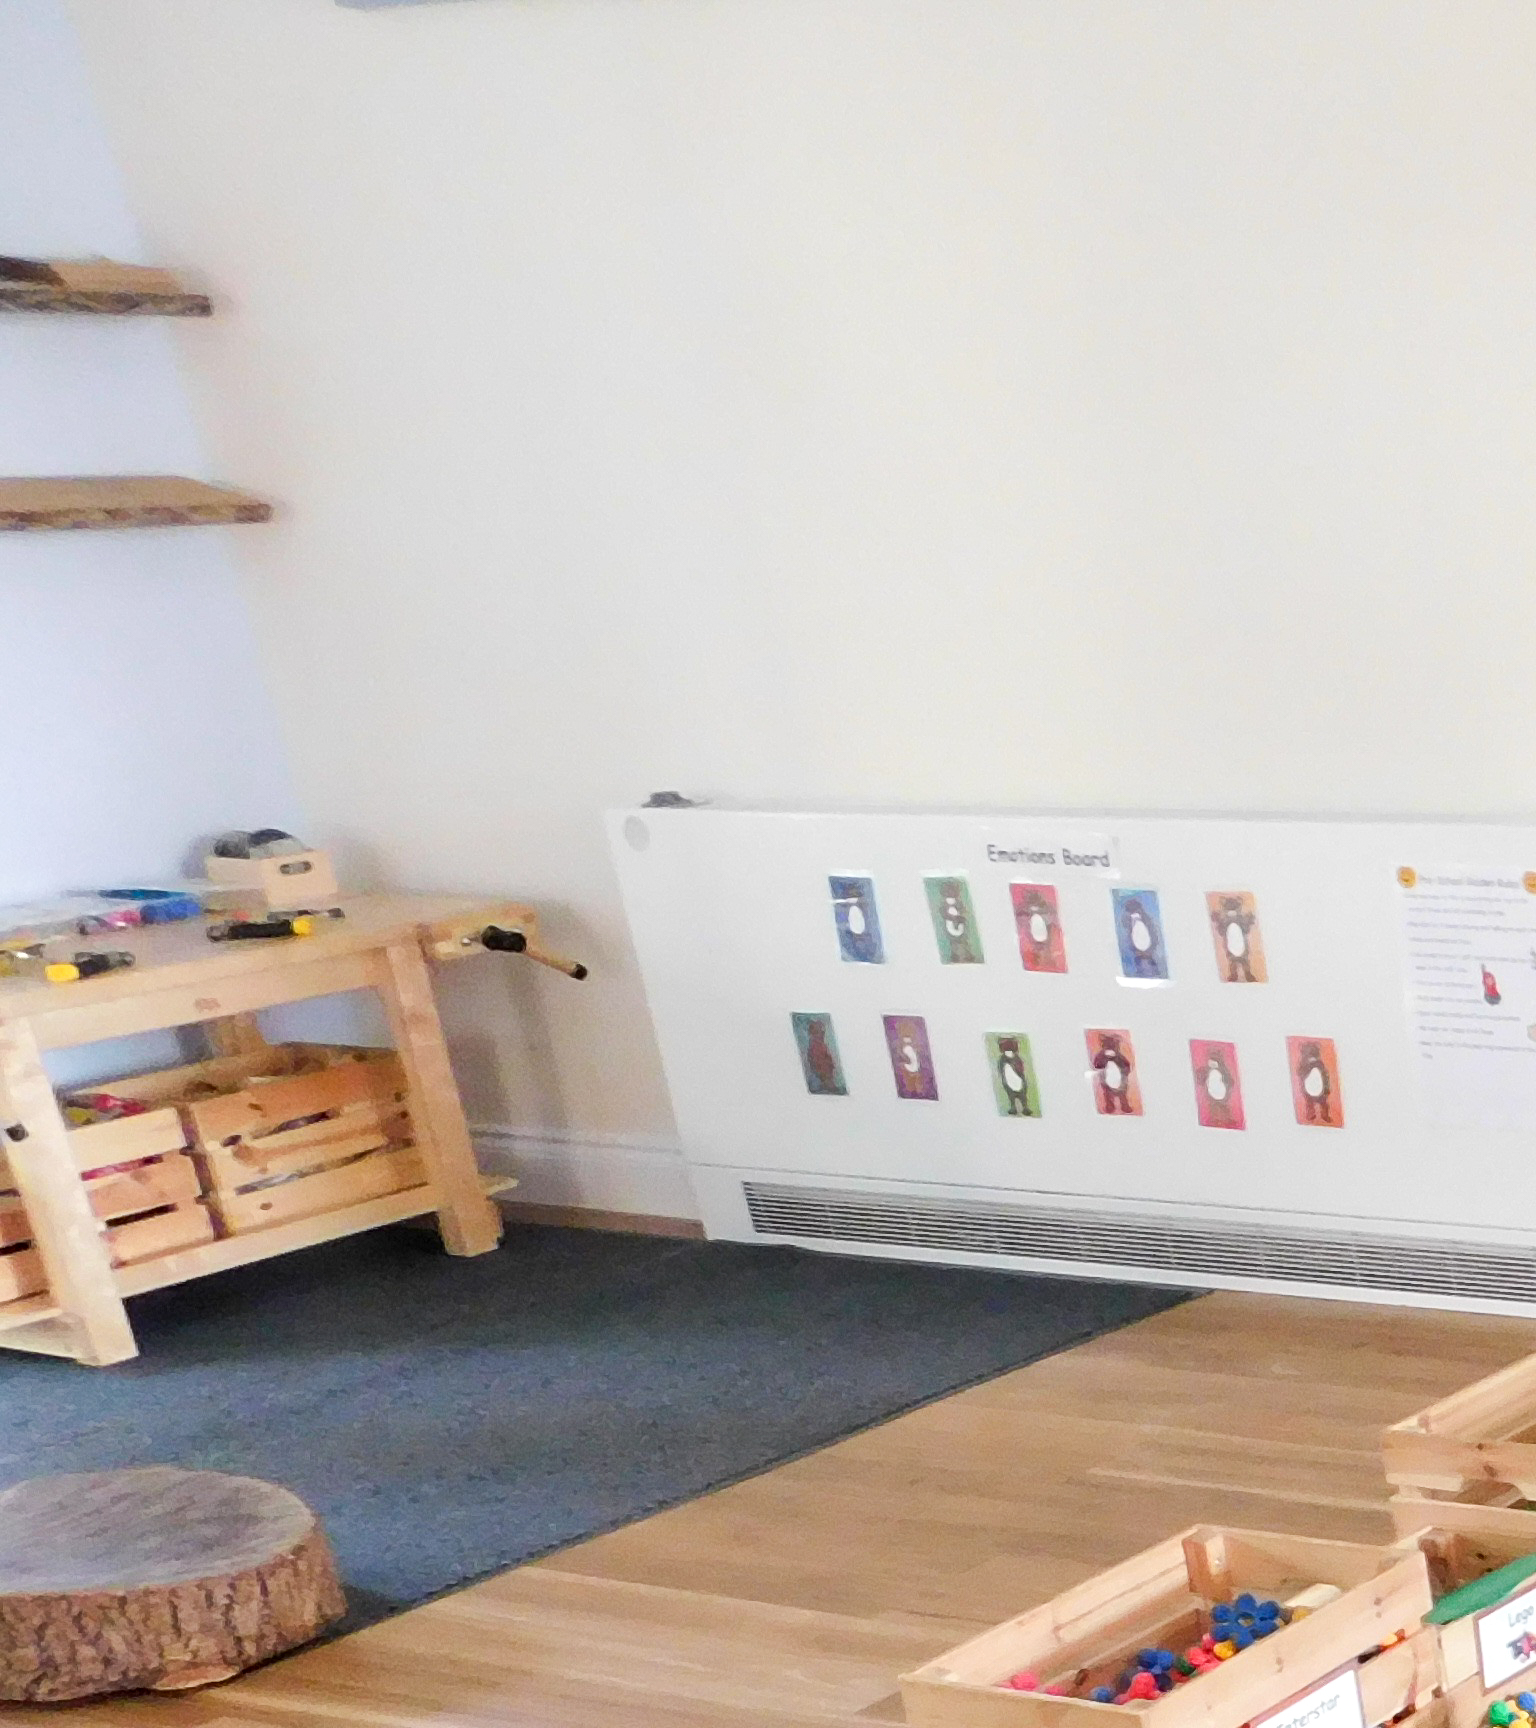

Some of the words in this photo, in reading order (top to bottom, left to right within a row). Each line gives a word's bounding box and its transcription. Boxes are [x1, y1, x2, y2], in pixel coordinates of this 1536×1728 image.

[987, 844, 1056, 864] Emotions
[1062, 848, 1110, 867] Board
[1508, 1605, 1534, 1627] Lego
